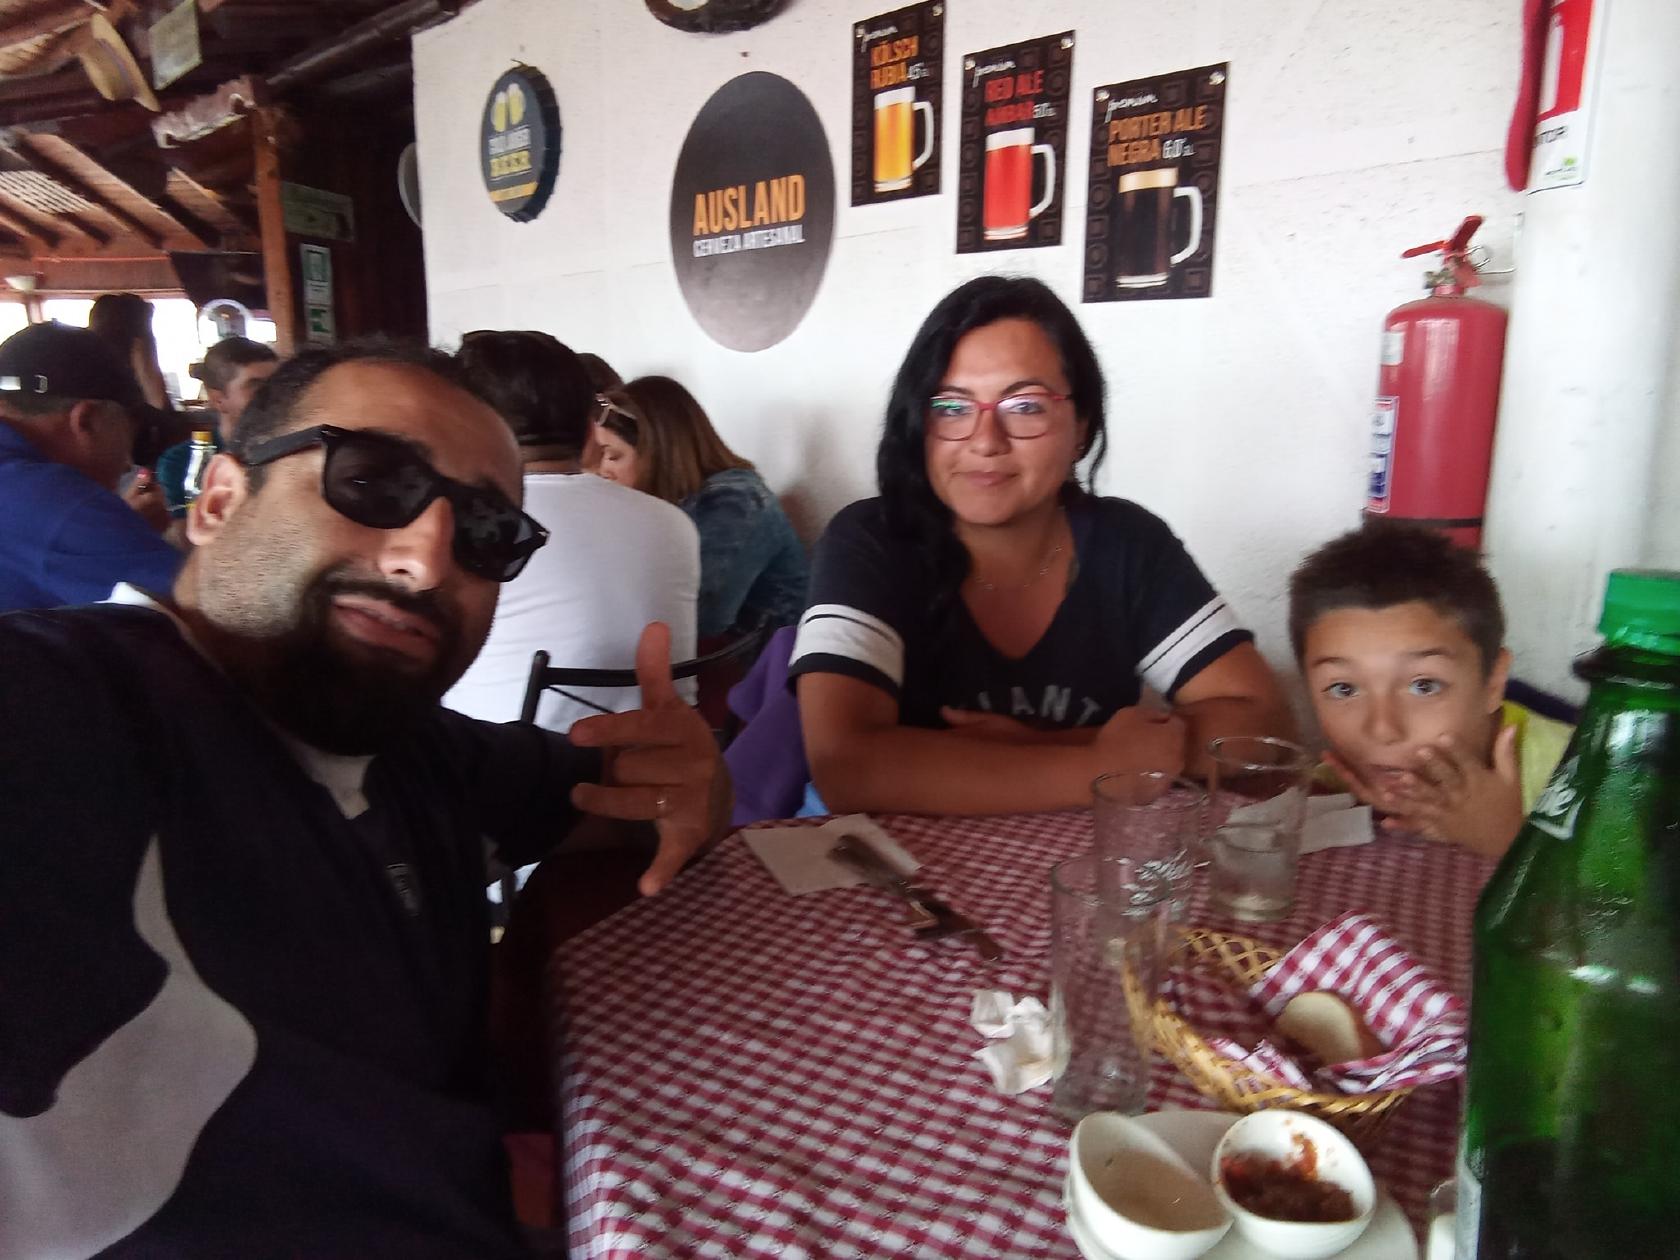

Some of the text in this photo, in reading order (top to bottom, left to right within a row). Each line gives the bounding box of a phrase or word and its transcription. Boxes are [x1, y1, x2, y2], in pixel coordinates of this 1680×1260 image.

[984, 69, 1045, 103] RED ALE
[1108, 105, 1208, 144] PORTER ALE
[1107, 138, 1161, 168] NEGRA
[693, 174, 806, 237] AUSLAND
